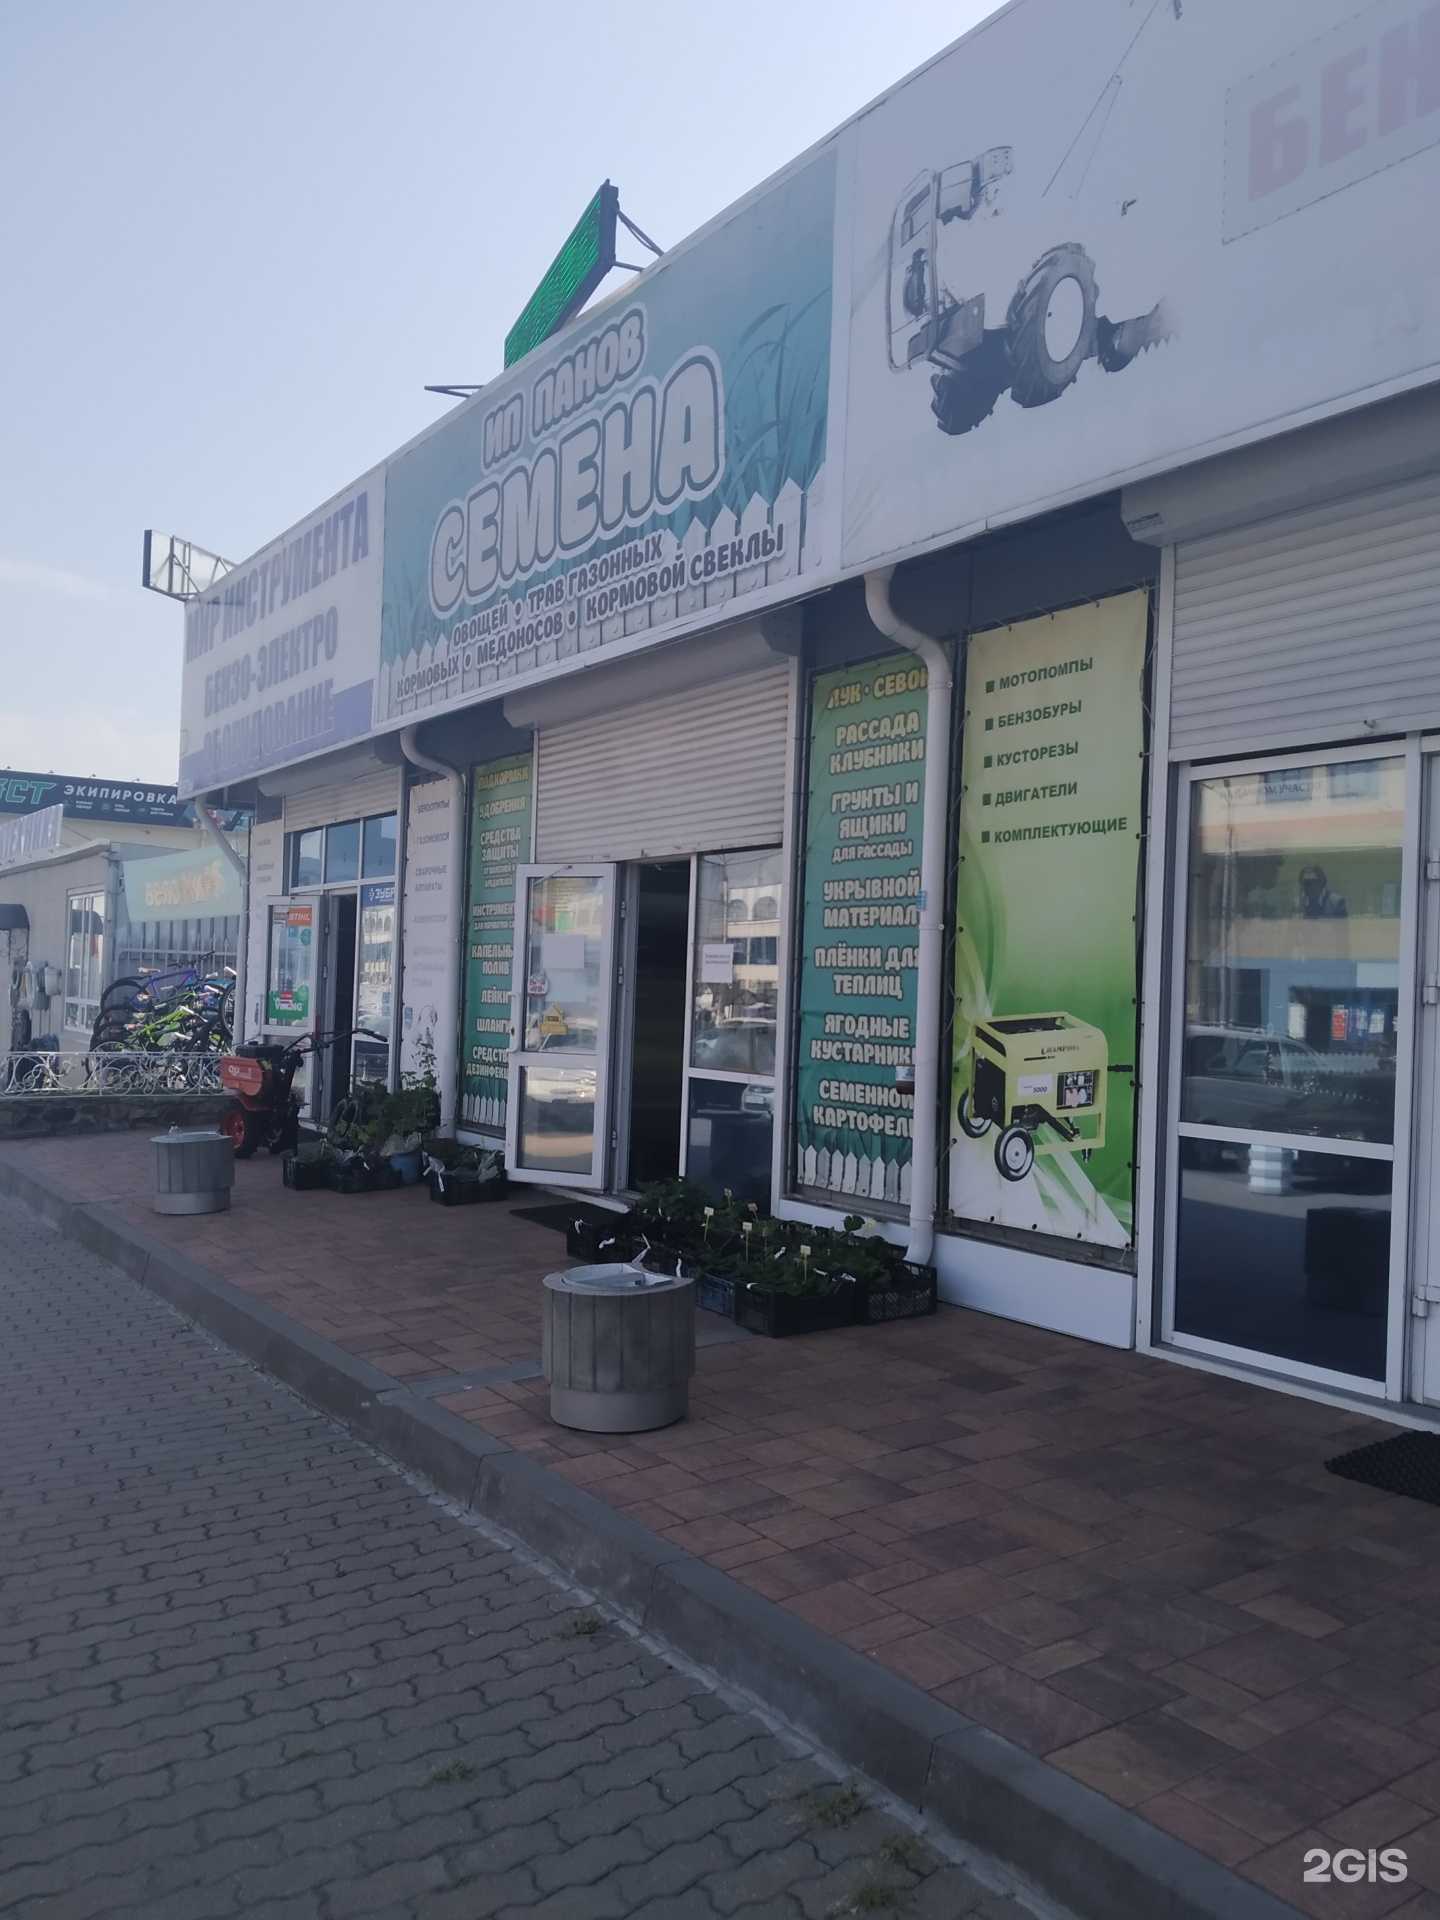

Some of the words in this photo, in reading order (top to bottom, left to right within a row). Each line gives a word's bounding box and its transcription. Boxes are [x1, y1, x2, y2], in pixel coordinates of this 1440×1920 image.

[484, 393, 523, 468] ИП
[532, 309, 645, 437] ПАНОВ
[431, 355, 720, 614] СЕМЕНА
[222, 491, 368, 643] ИНСТРУМЕНТА
[453, 601, 509, 647] ОВОЩЕЙ
[527, 584, 564, 613] ТРАВ
[568, 535, 662, 596] ГАЗОННЫХ
[397, 657, 460, 698] КОРМОВЫХ
[477, 619, 563, 669] МЕДОНОСОВ
[586, 557, 685, 624] КОРМОВОЙ
[690, 525, 784, 581] СВЕКЛЫ
[204, 605, 338, 718] БЕНЗО-ЭЛЕКТРО
[999, 657, 1093, 690] МОТОПОМПЫ
[827, 682, 862, 709] ЛУК
[998, 700, 1082, 728] БЕНЗОБУРЫ
[835, 711, 920, 746] РАССАДА
[830, 738, 924, 774] КЛУБНИКИ
[996, 741, 1079, 767] КУСТОРЕЗЫ
[64, 785, 177, 805] ЭКИПИРОВКА
[831, 783, 900, 813] ГРУНТЫ
[905, 781, 918, 803] И
[995, 782, 1078, 807] ДВИГАТЕЛИ
[480, 827, 521, 846] СРЕДСТВА
[839, 812, 907, 839] ЯЩИКИ
[994, 817, 1127, 844] КОМПЛЕКТУЮЩИЕ
[482, 845, 519, 861] ЗАЩИТЫ
[832, 846, 856, 863] ДЛЯ
[857, 840, 912, 859] РАССАДЫ
[824, 871, 920, 901] УКРЫВНОЙ
[824, 904, 917, 928] МАТЕРИАЛ
[815, 943, 882, 969] ПЛЁНКИ
[833, 974, 903, 1000] ТЕПЛИЦ
[824, 1013, 910, 1039] ЯГОДНЫЕ
